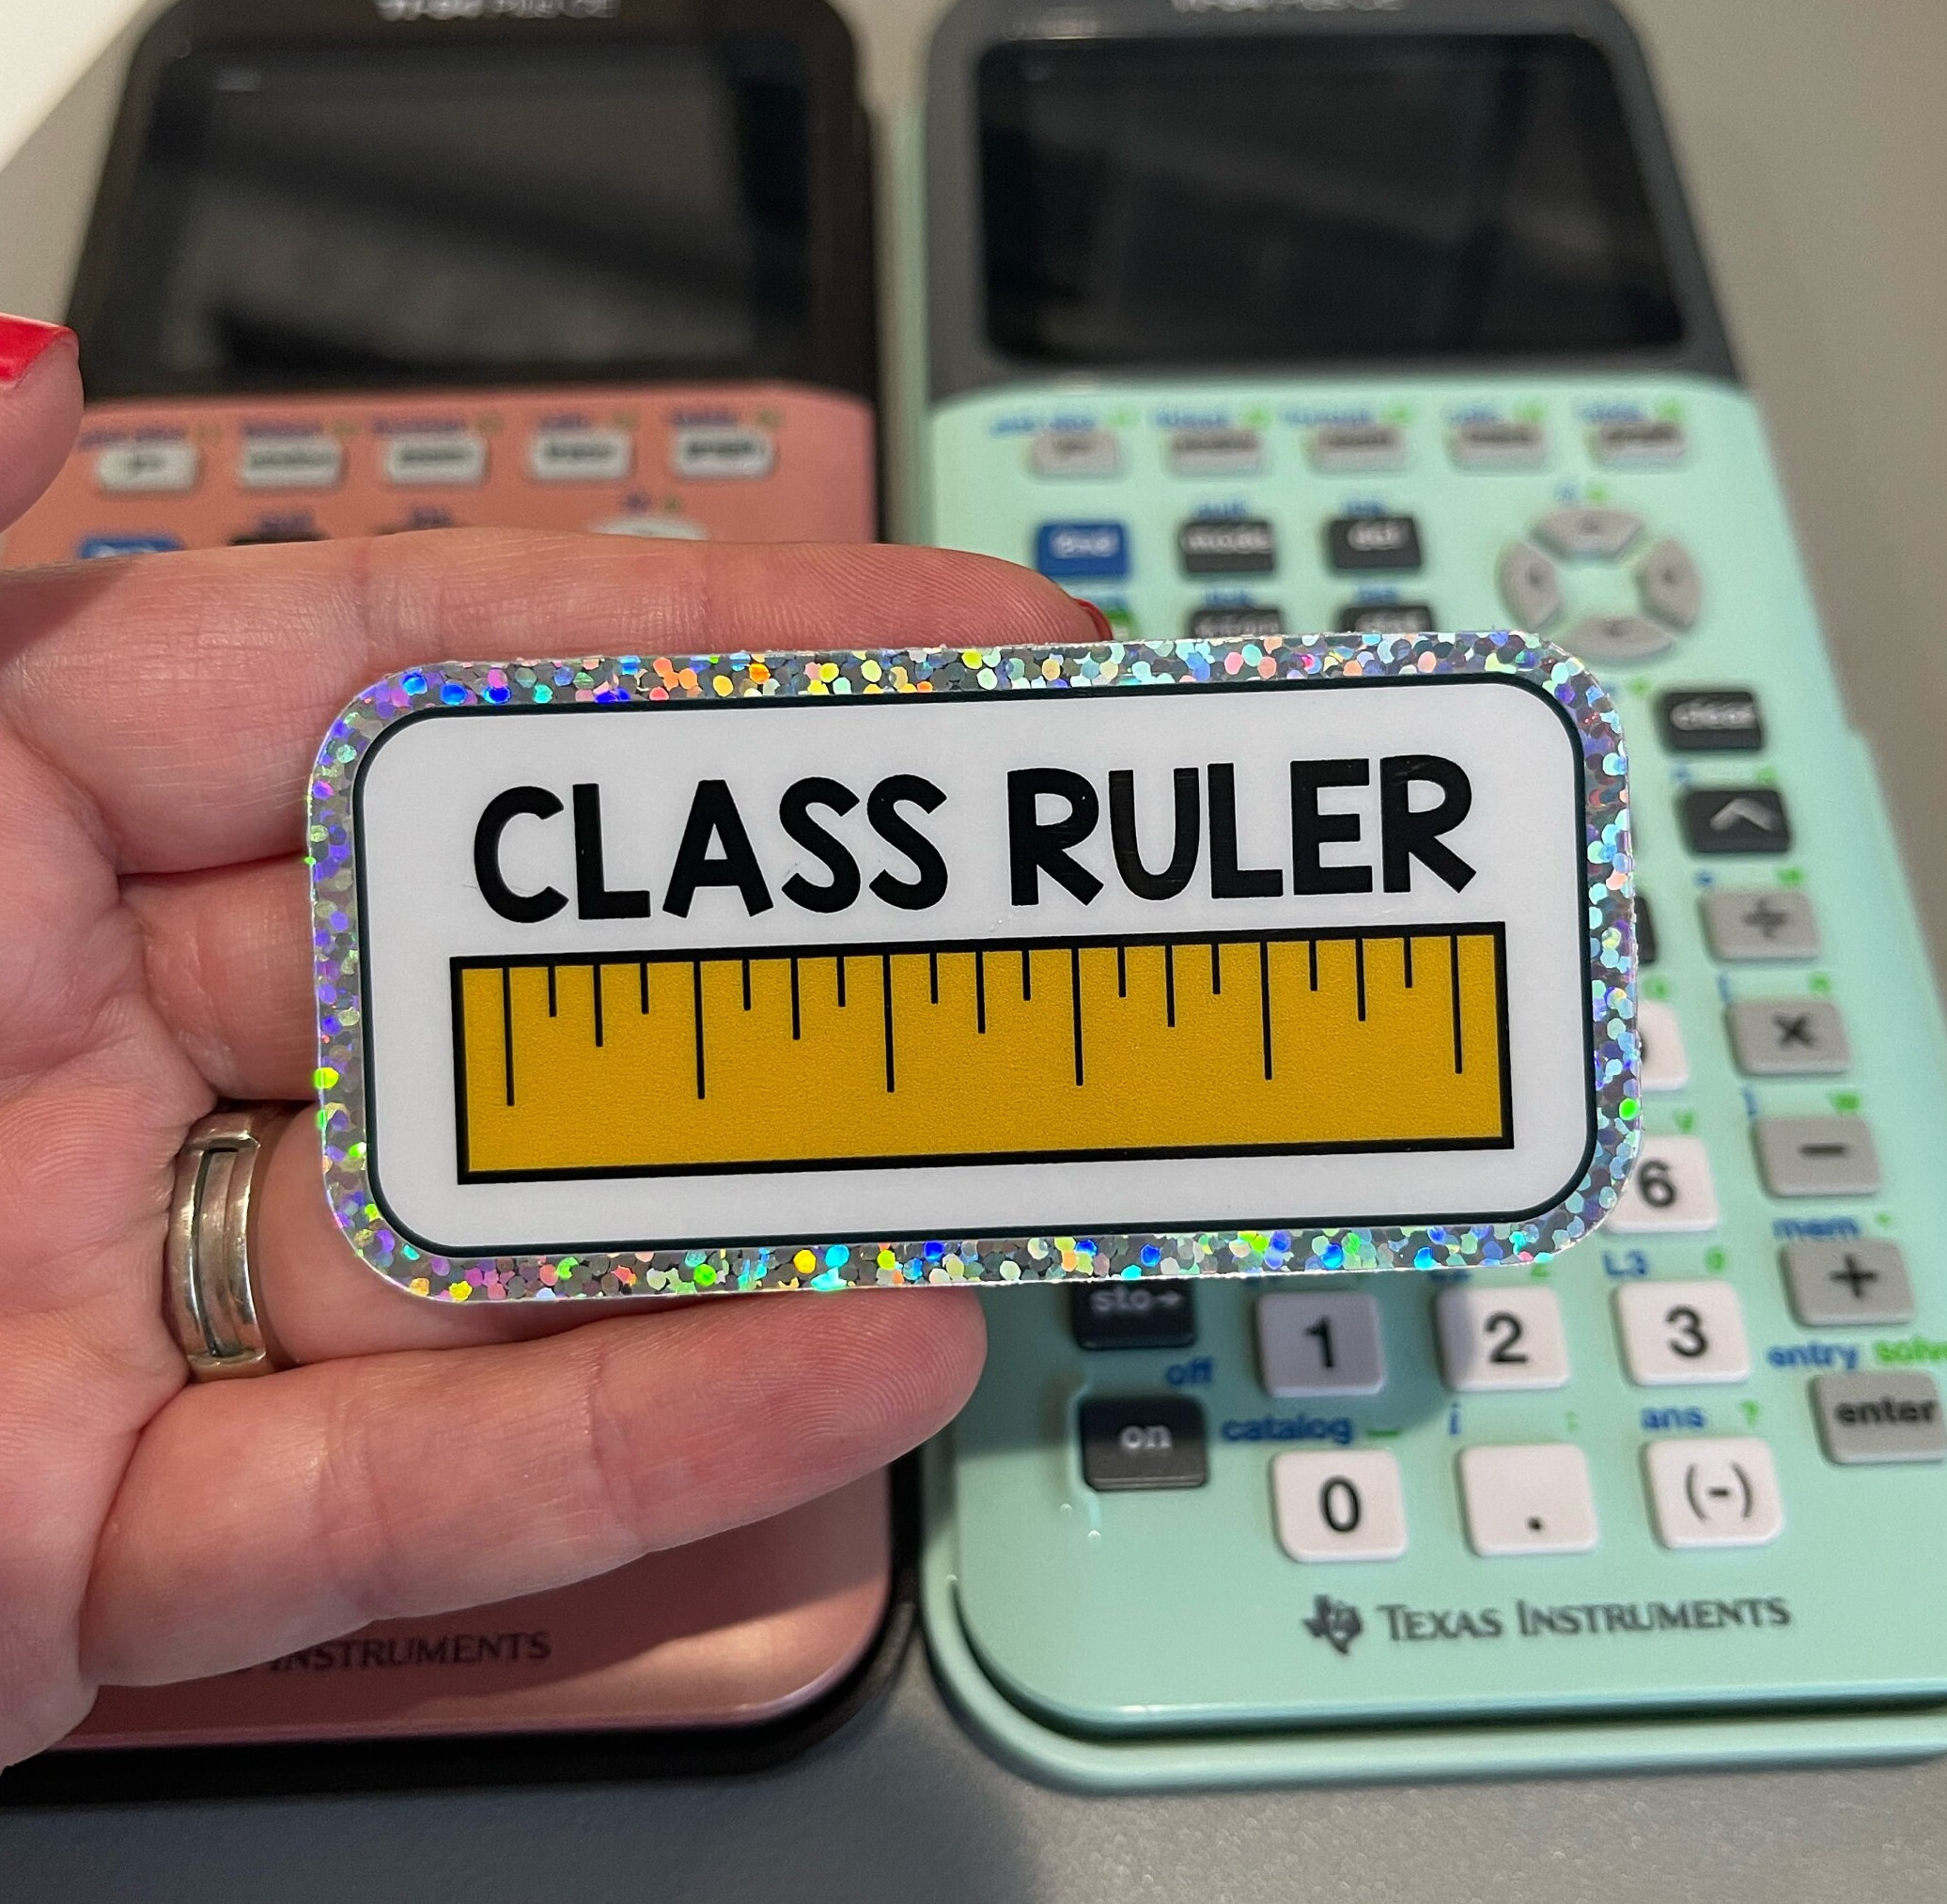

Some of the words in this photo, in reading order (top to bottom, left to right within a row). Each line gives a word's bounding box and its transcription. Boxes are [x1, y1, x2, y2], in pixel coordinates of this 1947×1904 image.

[475, 774, 947, 923] CLASS
[1007, 755, 1476, 906] RULER
[1638, 1159, 1677, 1209] 6
[1304, 1316, 1335, 1368] 1
[1485, 1311, 1529, 1365] 2
[1664, 1304, 1709, 1360] 3
[1165, 1357, 1213, 1387] off
[1767, 1341, 1858, 1373] entry
[1222, 1412, 1353, 1444] catalog
[1641, 1406, 1706, 1430] ans
[1835, 1397, 1939, 1426] enter
[1118, 1423, 1173, 1451] on
[1319, 1474, 1362, 1534] 0
[1376, 1603, 1505, 1641] TEXAS
[1515, 1596, 1793, 1636] INSTRUMENTS
